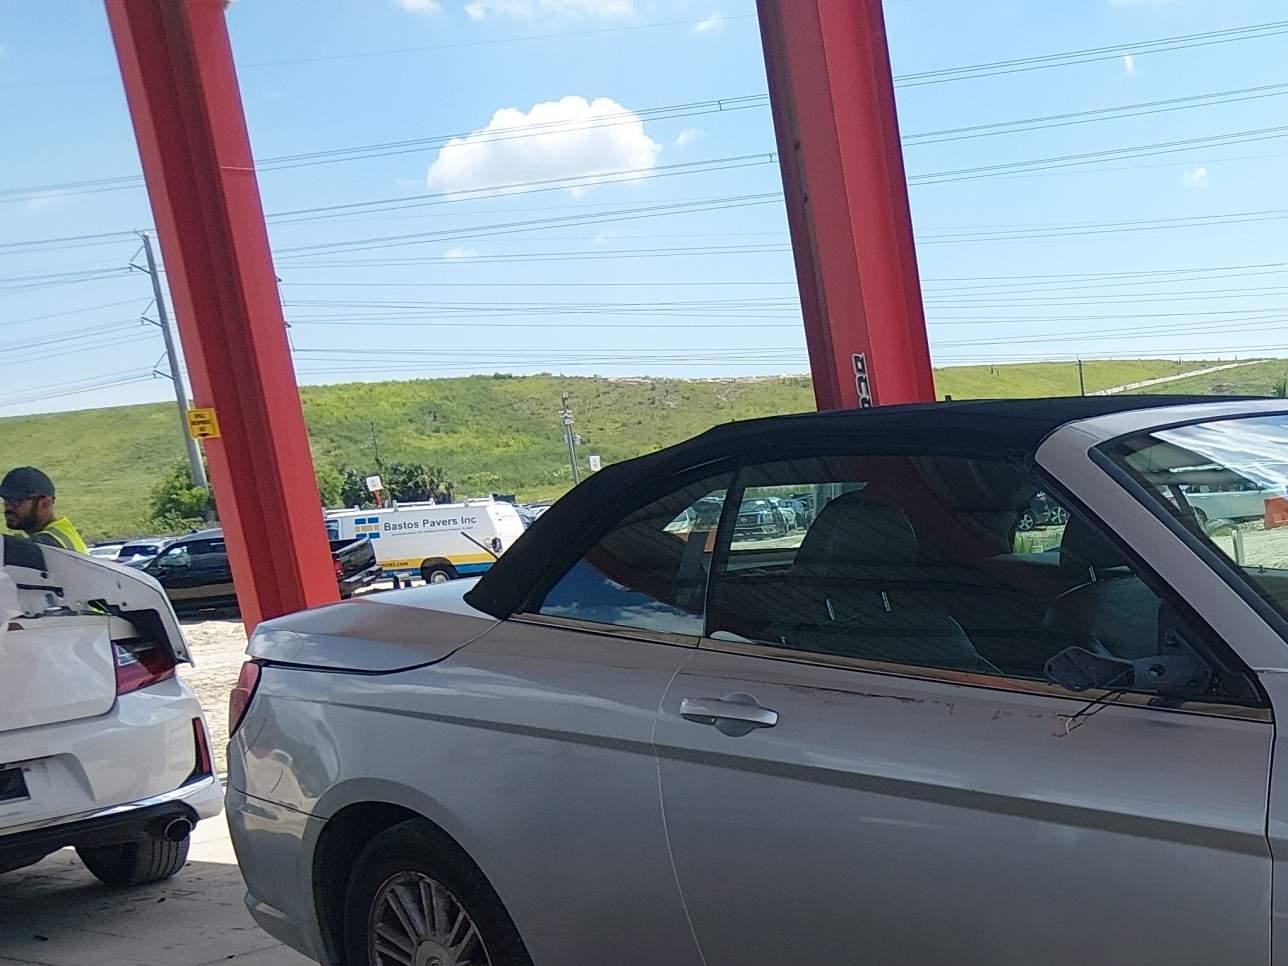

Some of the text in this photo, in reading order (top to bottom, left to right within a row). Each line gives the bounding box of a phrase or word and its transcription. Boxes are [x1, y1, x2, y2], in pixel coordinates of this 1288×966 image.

[384, 521, 419, 532] Bastos
[422, 518, 458, 528] Pavers
[461, 516, 477, 525] Inc
